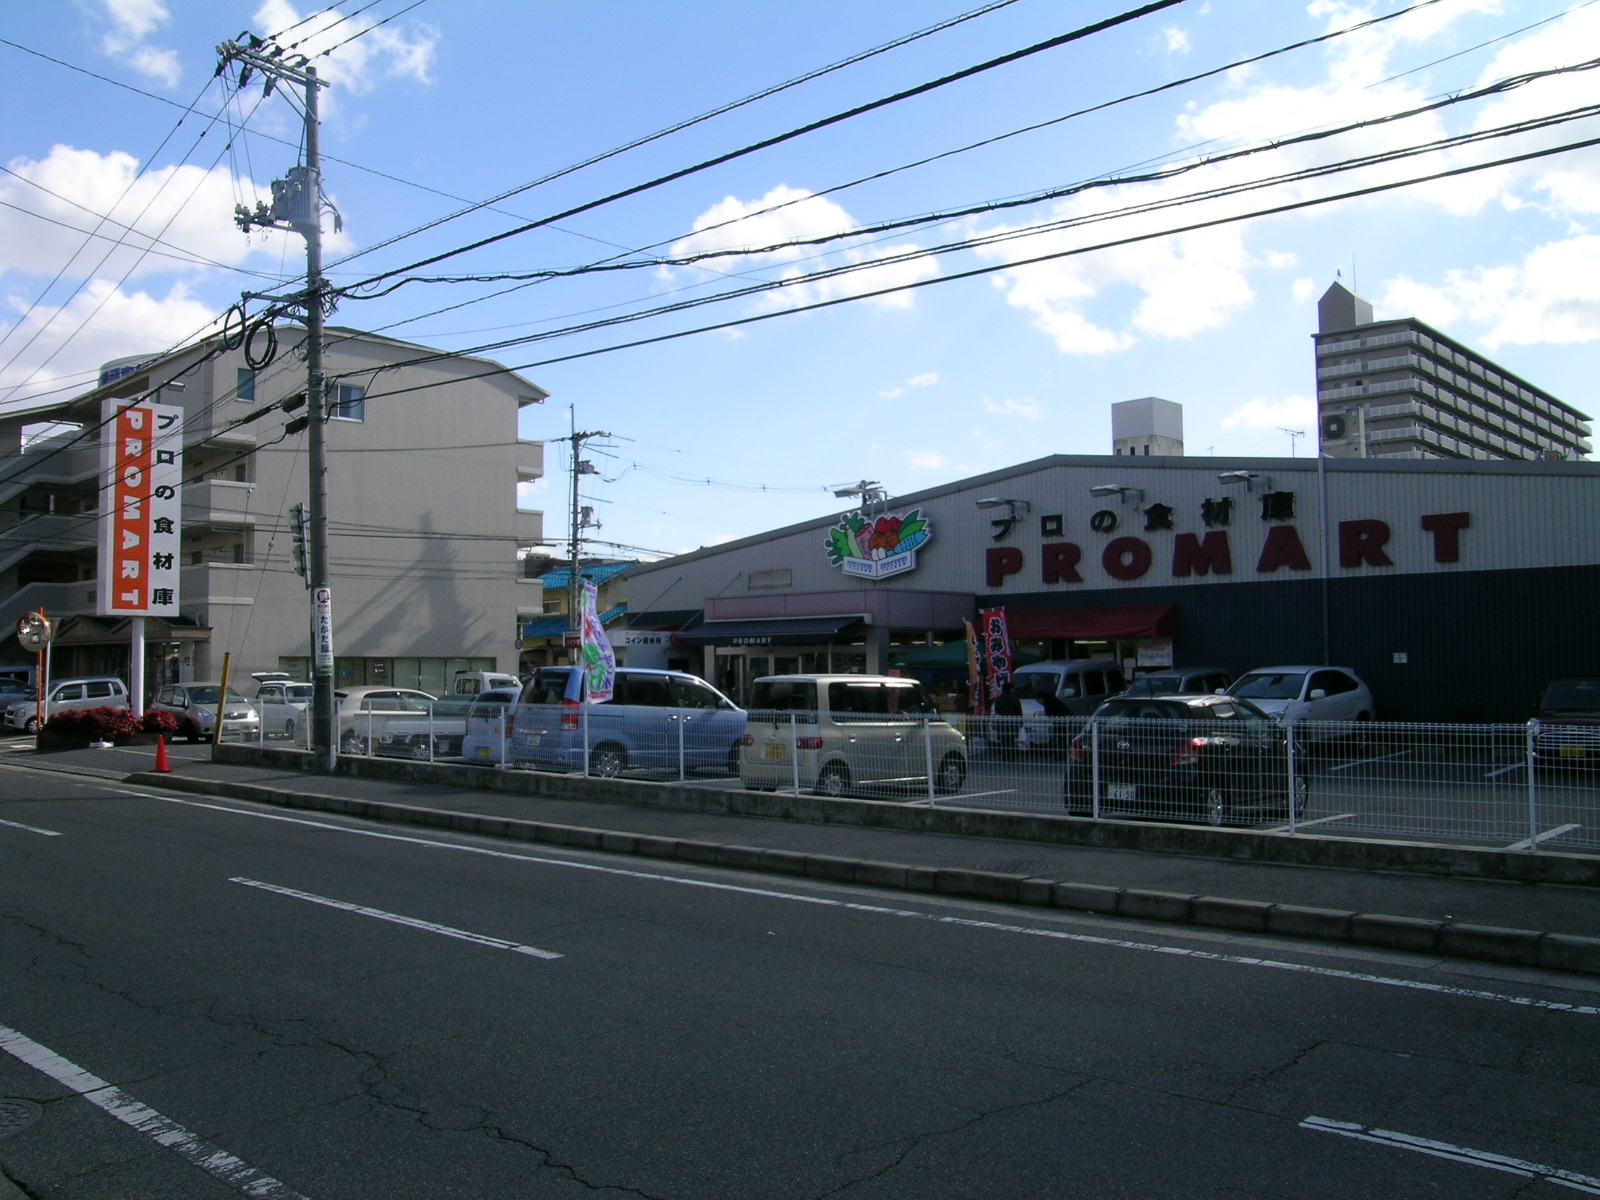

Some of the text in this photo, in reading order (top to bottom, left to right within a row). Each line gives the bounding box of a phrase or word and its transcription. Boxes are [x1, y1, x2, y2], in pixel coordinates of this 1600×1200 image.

[121, 410, 143, 605] PROMART
[152, 414, 178, 605] プロの食材庫
[985, 512, 1470, 587] PROMART
[991, 491, 1295, 541] プロの食材庫
